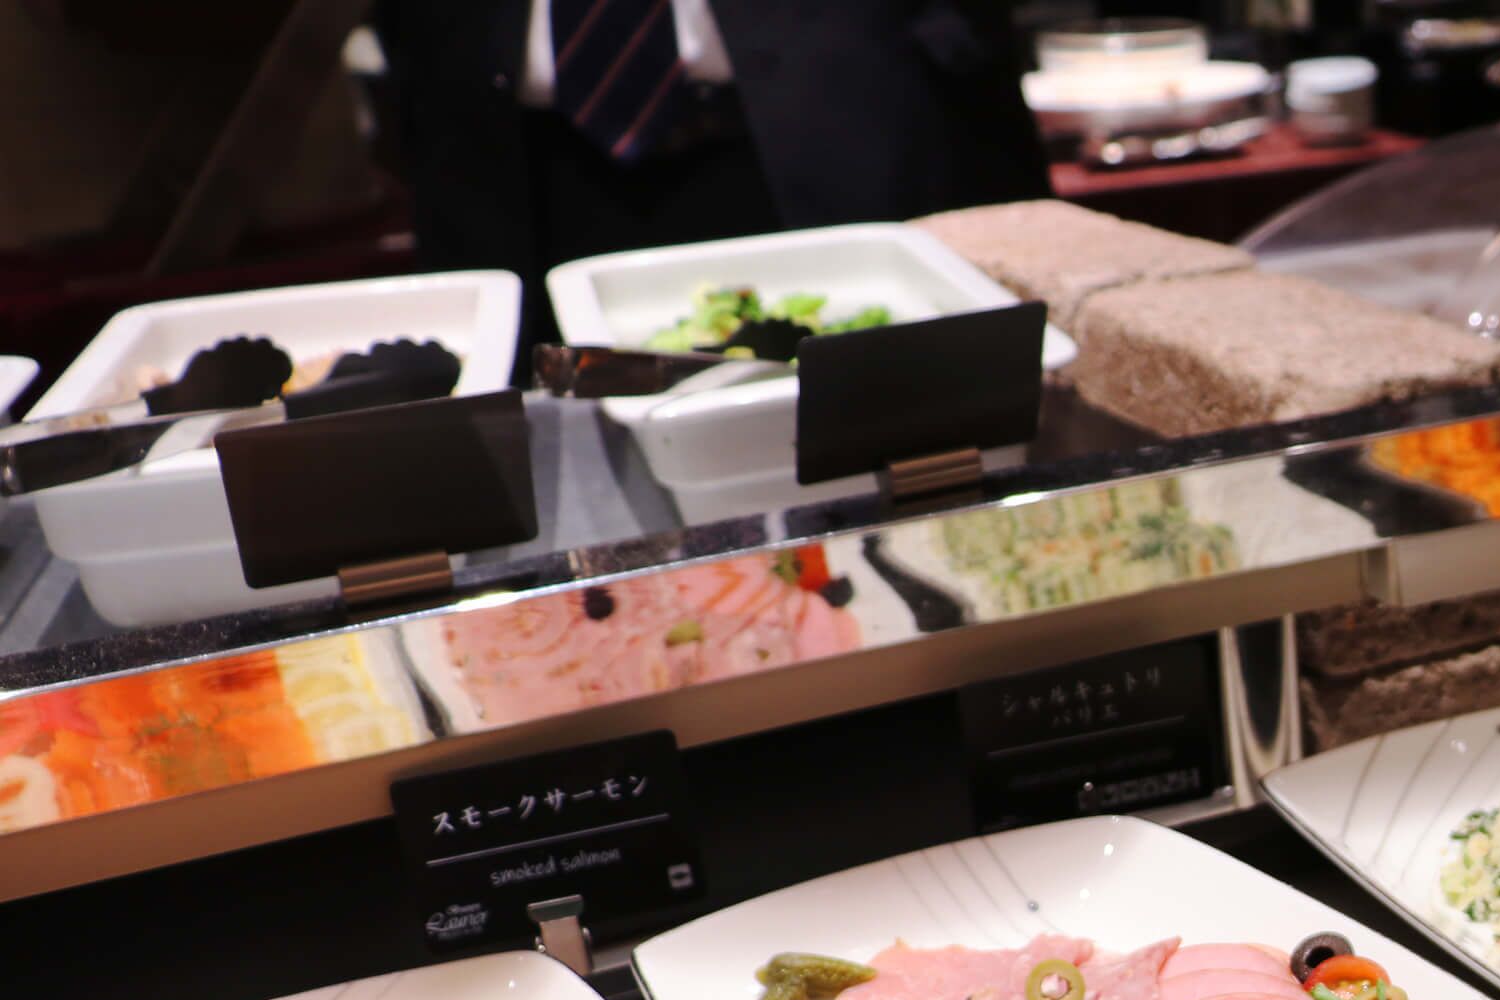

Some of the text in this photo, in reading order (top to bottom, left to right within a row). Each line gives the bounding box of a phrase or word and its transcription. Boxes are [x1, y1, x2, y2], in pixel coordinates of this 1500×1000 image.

[433, 774, 648, 835] スモークサーモン
[490, 847, 622, 887] smoked salmon
